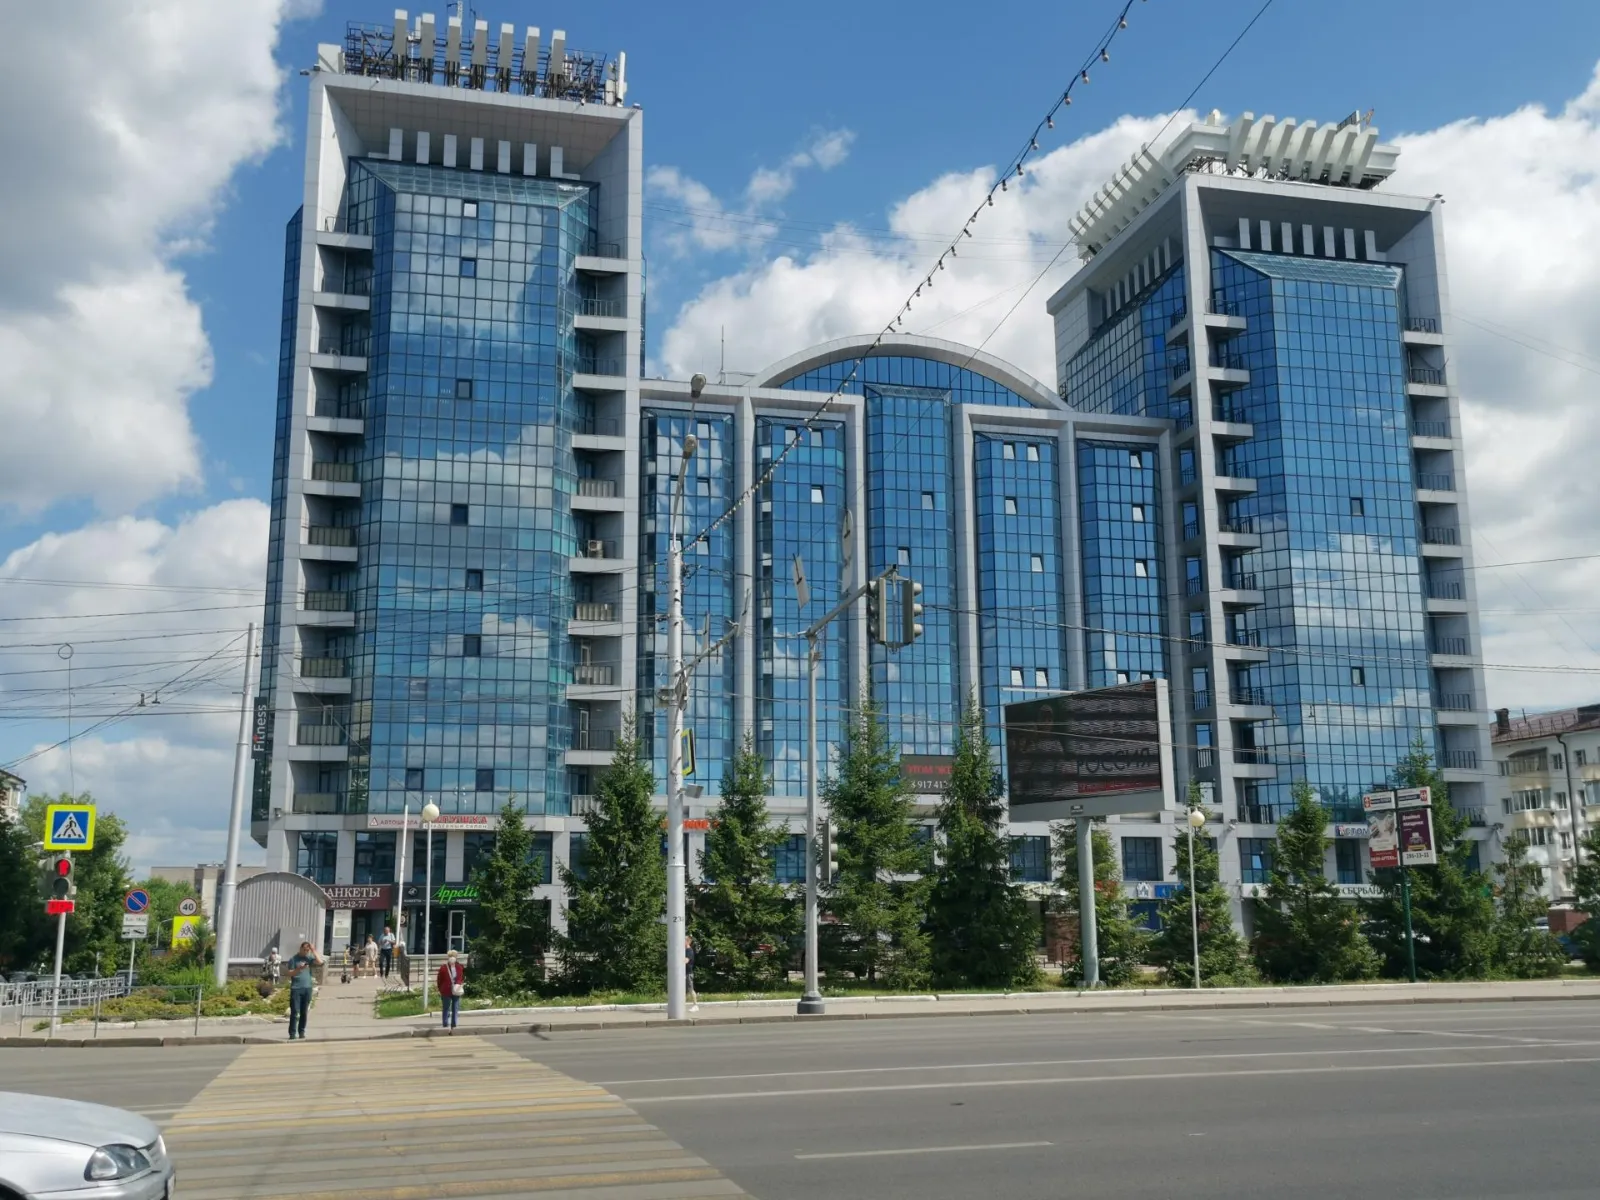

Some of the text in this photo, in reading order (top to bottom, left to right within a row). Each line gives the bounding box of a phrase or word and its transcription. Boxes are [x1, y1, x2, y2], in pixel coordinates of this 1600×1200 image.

[253, 704, 267, 752] Fitness
[182, 903, 194, 911] 40
[330, 900, 368, 909] 216-42-77
